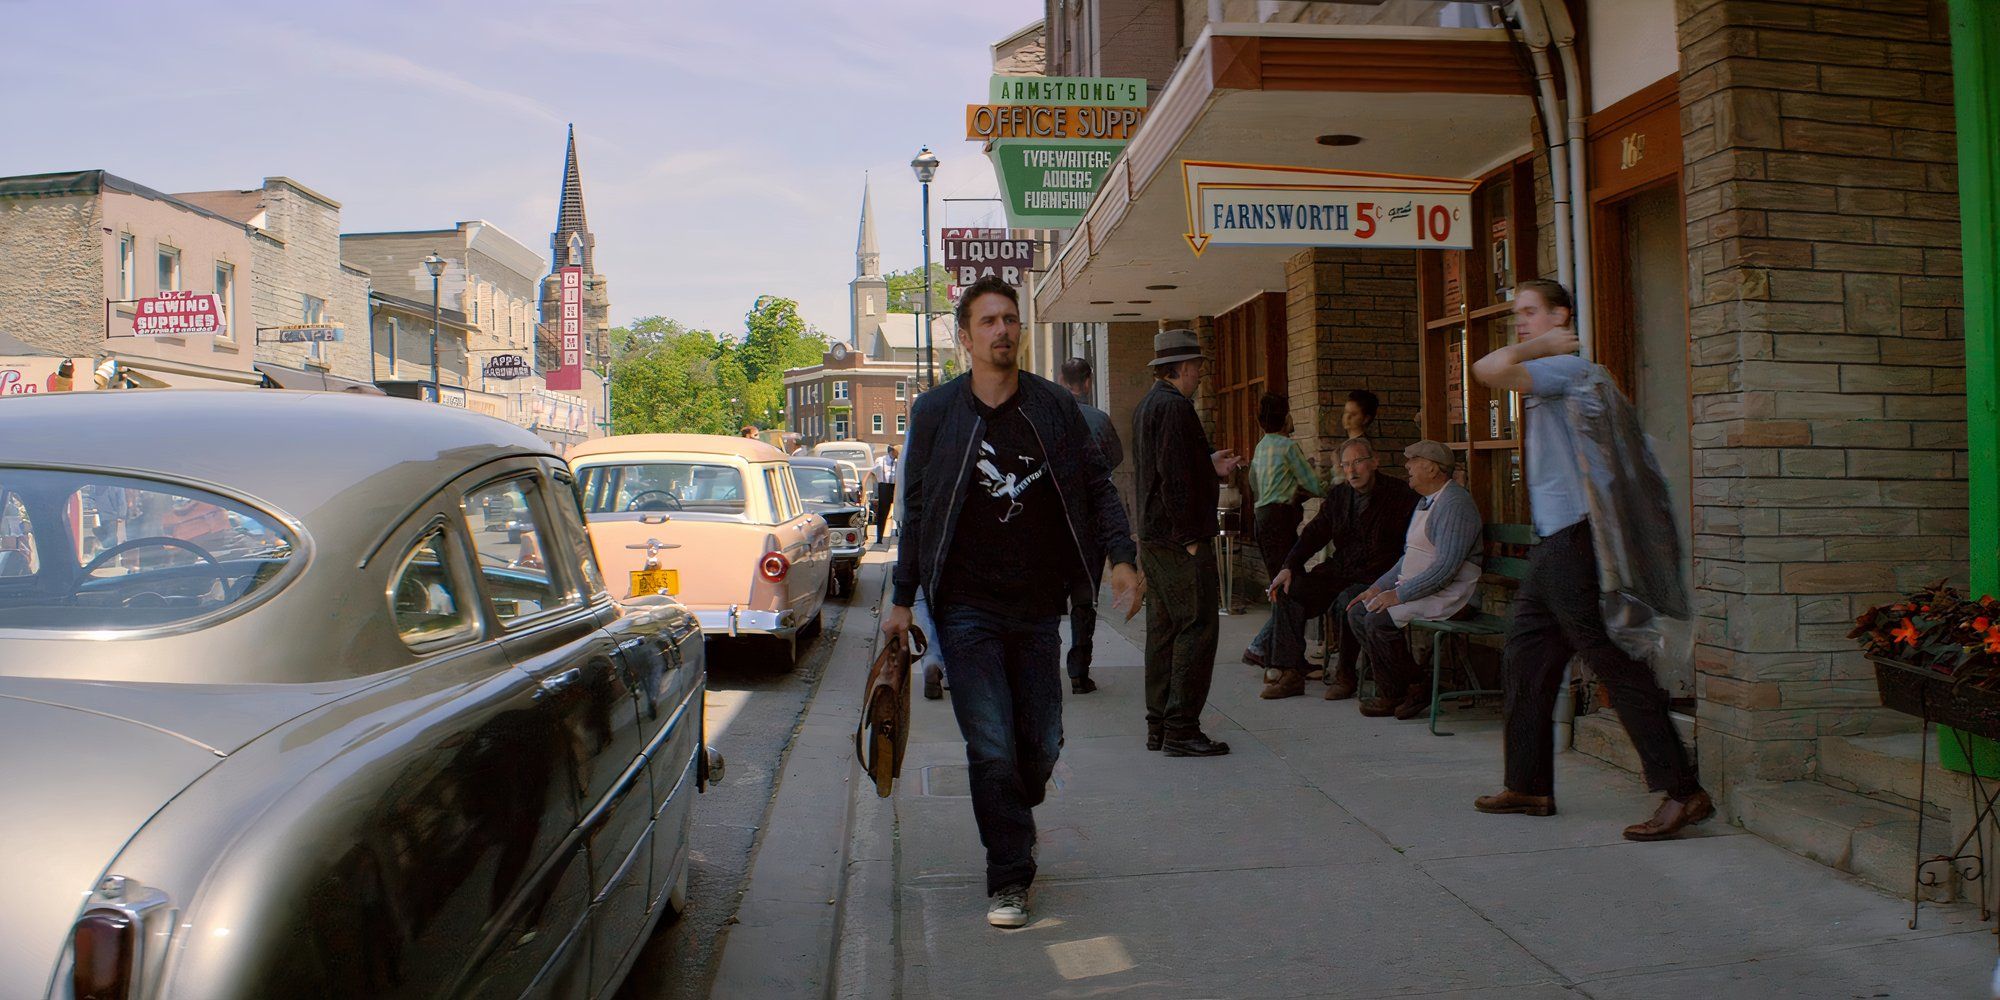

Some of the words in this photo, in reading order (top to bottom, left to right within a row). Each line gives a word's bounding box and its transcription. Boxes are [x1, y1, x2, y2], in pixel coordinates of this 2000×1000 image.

[1001, 81, 1136, 101] ARMSTRONG'S
[974, 106, 1067, 138] OFFICE
[1023, 150, 1112, 168] TYPEWRITERS
[1042, 171, 1092, 188] ADDERS
[1213, 203, 1349, 231] FARNSWORTH
[1388, 200, 1412, 223] and
[948, 241, 1030, 263] LIQUOR
[960, 266, 1019, 285] BAR
[137, 315, 215, 329] SUPPLIES
